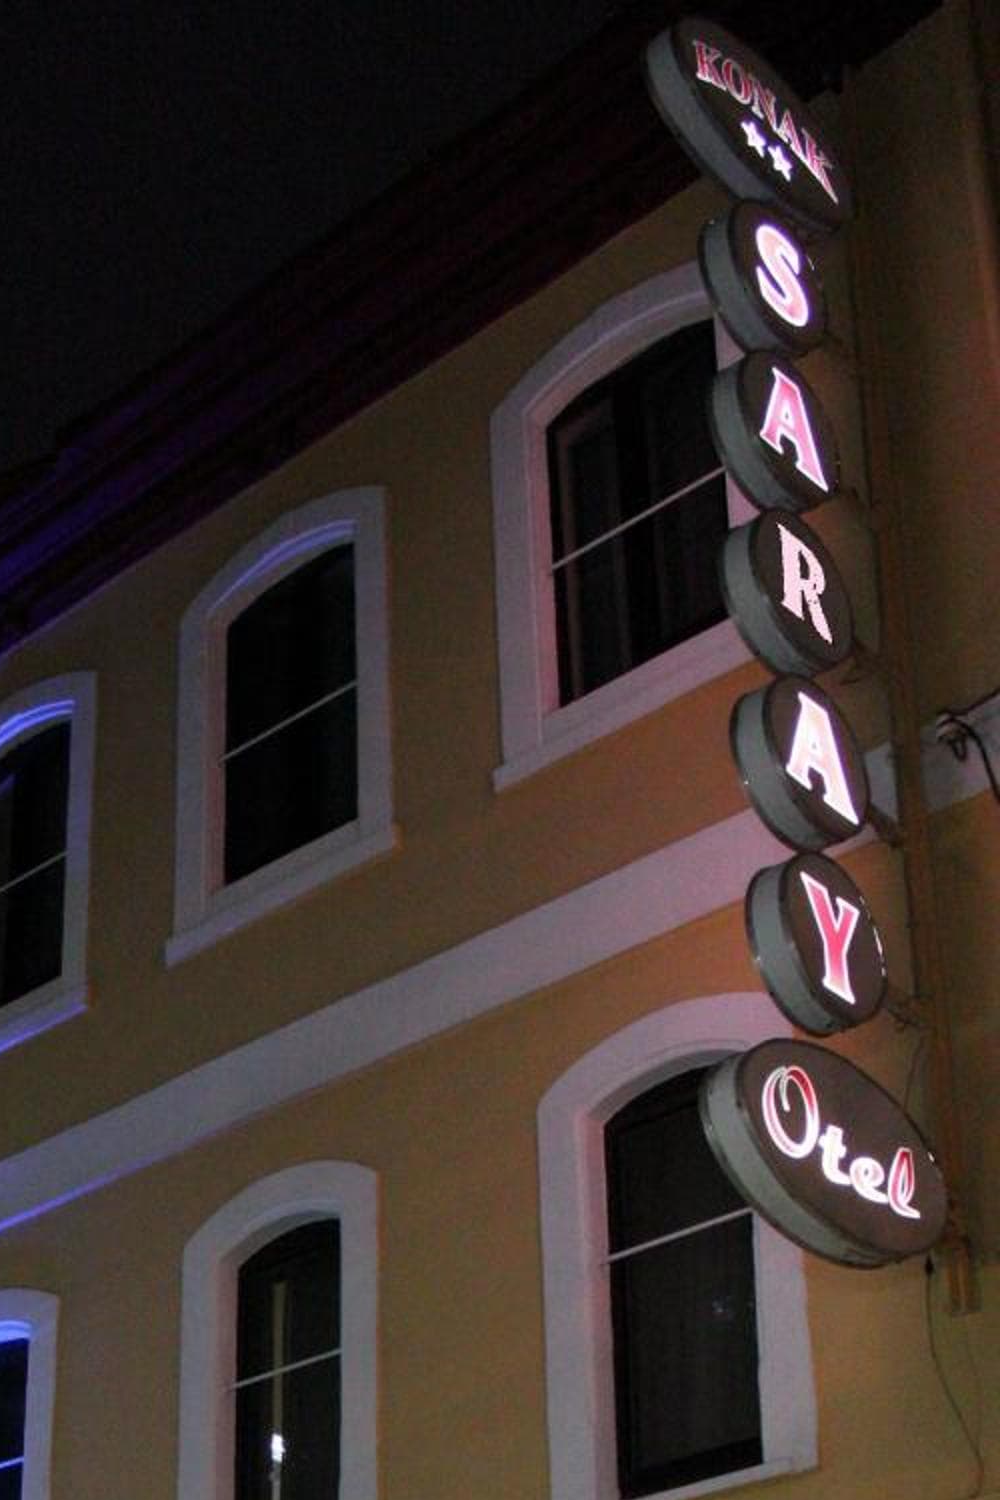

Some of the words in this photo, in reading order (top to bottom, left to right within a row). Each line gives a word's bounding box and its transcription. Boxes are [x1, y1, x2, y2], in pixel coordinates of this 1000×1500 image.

[691, 38, 839, 205] KONAK
[756, 223, 861, 1005] SARAY
[761, 1064, 922, 1219] Otel
